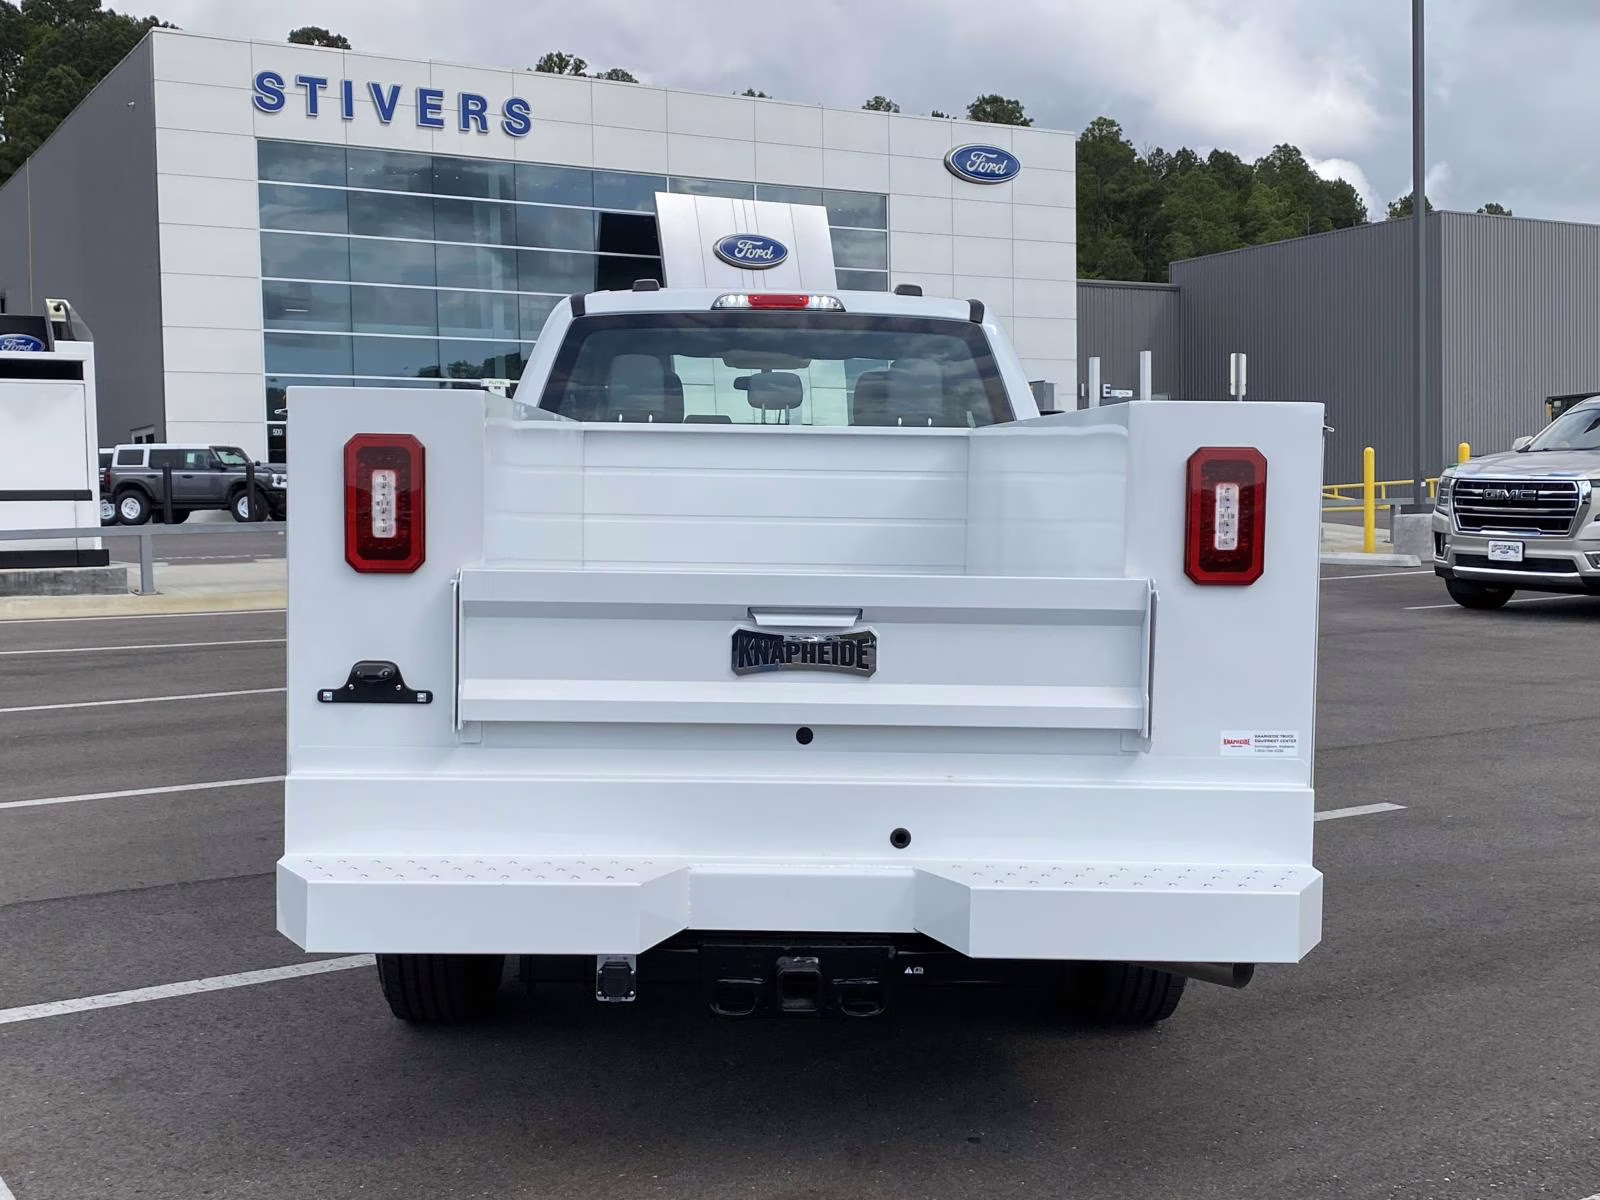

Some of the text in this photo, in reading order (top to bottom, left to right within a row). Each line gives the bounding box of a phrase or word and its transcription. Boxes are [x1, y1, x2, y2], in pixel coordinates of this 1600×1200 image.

[252, 70, 532, 137] STIVERS
[966, 151, 1008, 175] Ford
[734, 239, 774, 260] Ford
[1, 338, 34, 351] Ford
[272, 428, 283, 436] 500
[1483, 489, 1537, 500] GMC
[737, 634, 870, 670] KNAPHEIDE
